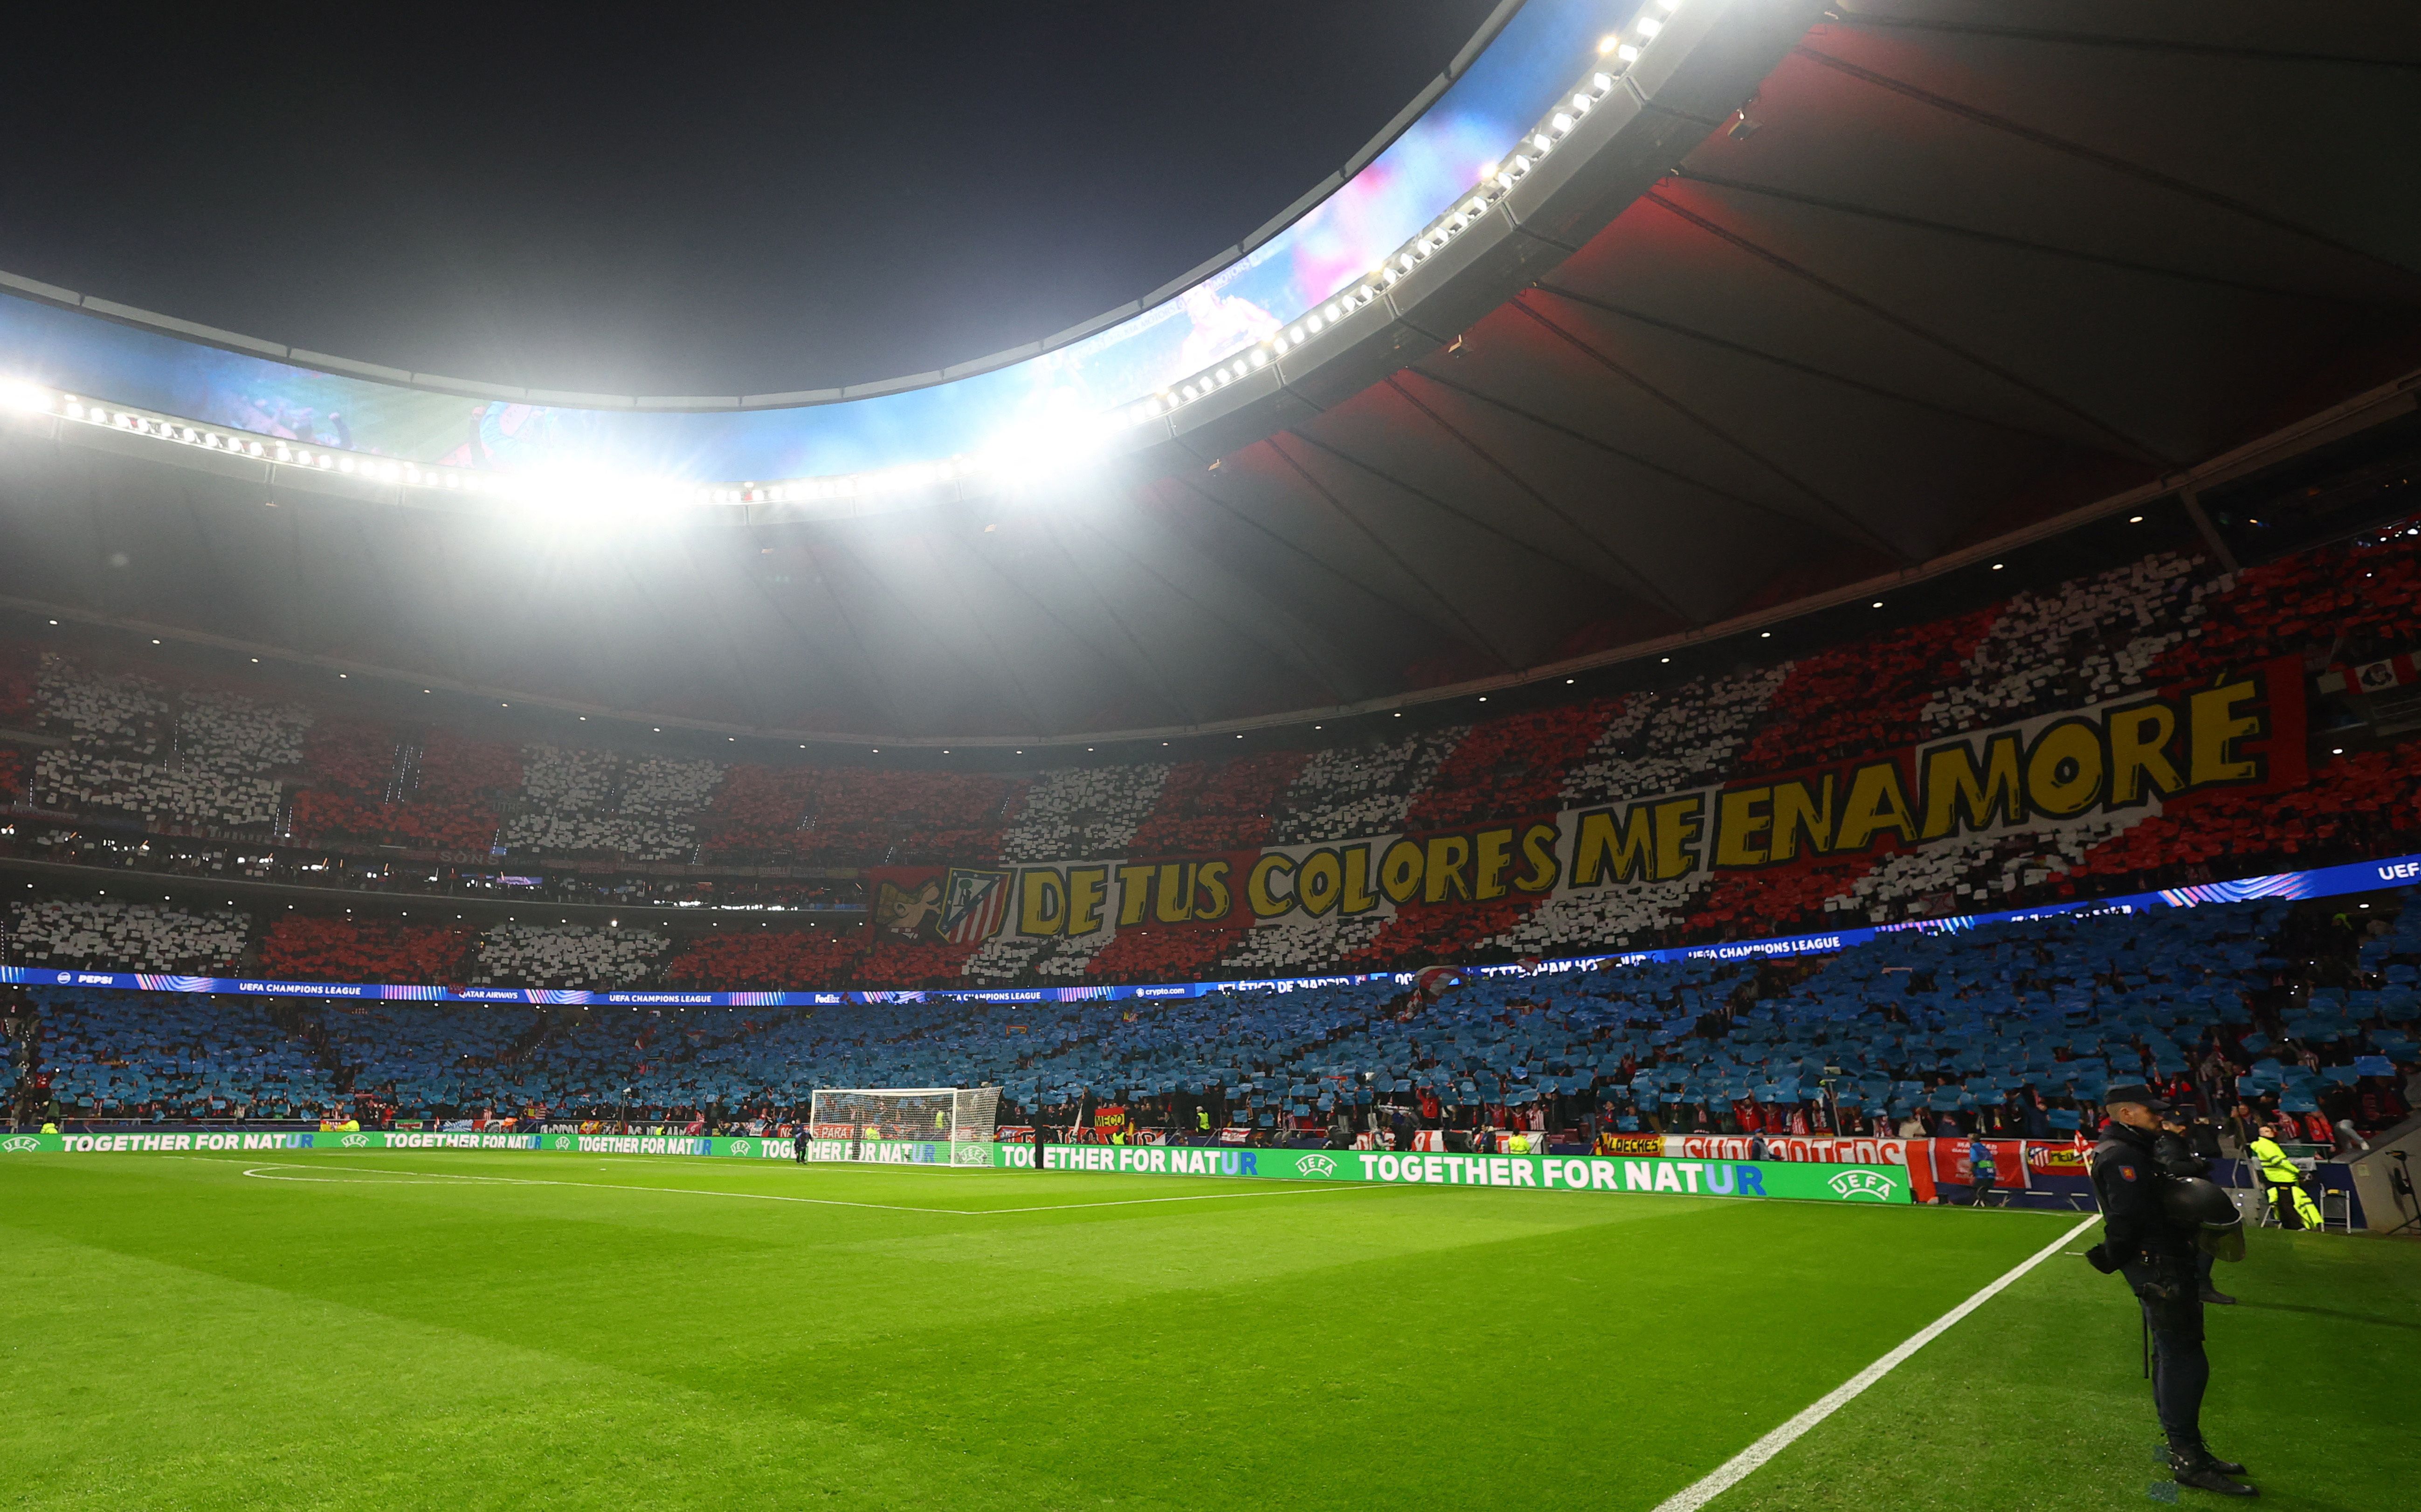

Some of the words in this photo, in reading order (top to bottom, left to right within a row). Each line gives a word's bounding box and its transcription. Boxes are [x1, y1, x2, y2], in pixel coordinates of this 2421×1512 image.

[1019, 868, 1110, 937] DE
[1118, 860, 1231, 926] TUS
[1246, 822, 1559, 918] COLORES
[1573, 798, 1701, 886] ME
[1714, 672, 2262, 868] ENAMORÉ
[2378, 862, 2421, 880] UEF
[1792, 936, 1841, 951] LEAGUE
[78, 974, 113, 984] PEPSI
[240, 982, 264, 992] UEFA
[266, 984, 323, 994] CHAMPIONS
[325, 986, 361, 995] LEAGUE
[459, 990, 484, 999] QATAR
[1145, 987, 1185, 996] crypto.com
[1277, 980, 1294, 994] DE
[815, 994, 840, 1003] FedEx
[963, 992, 1009, 1001] CAMPIONS
[1096, 1115, 1123, 1127] MECO
[2, 1137, 37, 1152] UEFA
[62, 1135, 190, 1151] TOGETHER
[195, 1134, 239, 1150] FOR
[243, 1133, 314, 1149] NATUR
[342, 1136, 367, 1147] UEFA
[384, 1133, 479, 1148] TOGETHER
[483, 1135, 507, 1149] FOR
[508, 1135, 541, 1149] NATUR
[578, 1137, 640, 1153] TOGETHER
[641, 1138, 666, 1153] FOR
[667, 1139, 712, 1155] NATUR
[731, 1141, 750, 1155] UEFA
[761, 1140, 841, 1160] TOGEHER
[879, 1143, 935, 1163] NATUR
[1120, 1148, 1166, 1173] FOR
[1171, 1150, 1257, 1175] NATUR
[1297, 1155, 1337, 1176] UEFA
[1359, 1154, 1537, 1187] TOGETHER
[1543, 1160, 1618, 1189] FOR
[1625, 1161, 1766, 1196] NATUR
[1831, 1174, 1892, 1201] UEFA
